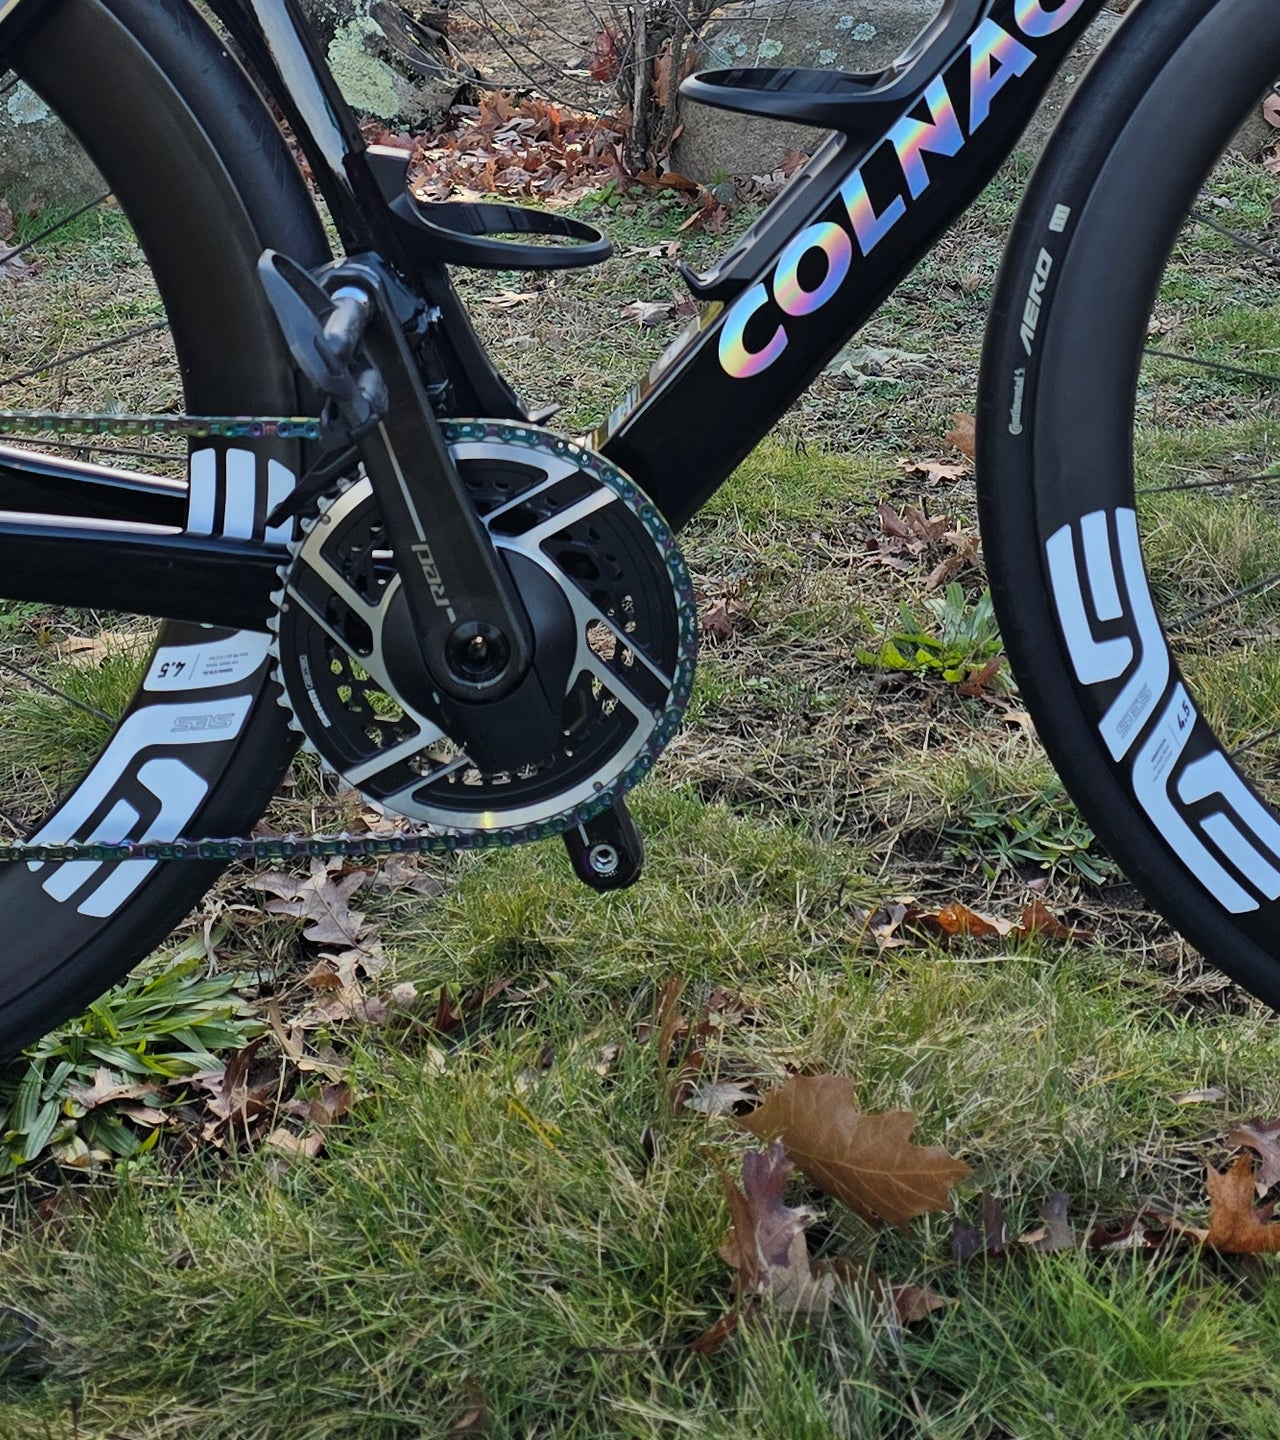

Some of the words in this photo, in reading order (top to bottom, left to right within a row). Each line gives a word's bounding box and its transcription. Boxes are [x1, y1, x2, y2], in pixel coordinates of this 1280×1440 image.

[1020, 246, 1053, 357] AERO
[157, 661, 186, 679] 4.5
[170, 712, 236, 733] SES
[1177, 698, 1190, 731] 4.5
